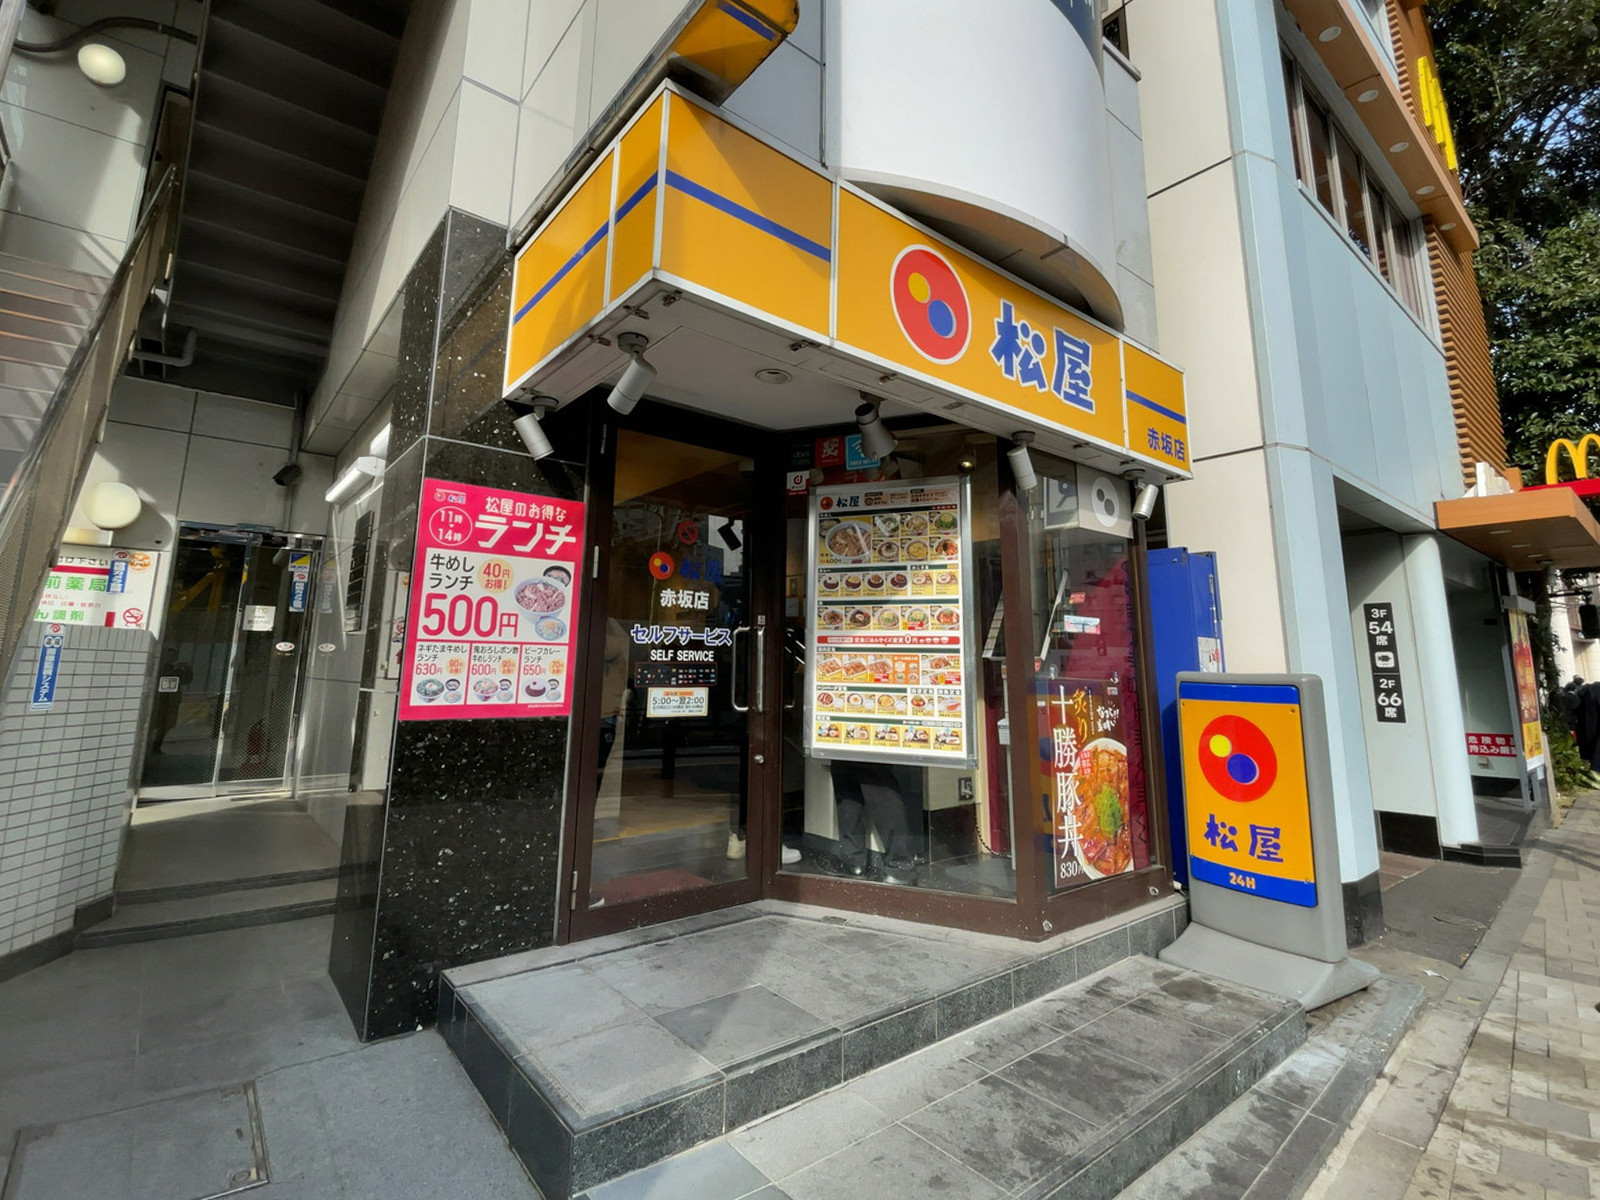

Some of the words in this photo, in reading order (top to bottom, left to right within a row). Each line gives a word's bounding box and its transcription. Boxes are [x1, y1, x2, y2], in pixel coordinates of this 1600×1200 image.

[989, 299, 1096, 414] 松屋
[1147, 427, 1185, 462] 赤坂店
[836, 495, 860, 508] 松屋
[485, 496, 567, 522] 松屋のお得な
[440, 509, 463, 524] 11時
[438, 528, 462, 542] 14時
[475, 514, 577, 556] ランチ
[430, 553, 475, 573] 牛めし
[483, 563, 510, 579] 40円
[46, 575, 107, 592] 前薬局
[429, 572, 474, 591] ランチ
[660, 588, 710, 610] 赤坂店
[421, 592, 519, 638] 500円
[1371, 608, 1387, 618] 3F
[1369, 621, 1393, 634] 54
[631, 624, 733, 646] セルフサービス
[1376, 635, 1388, 645] 席
[417, 644, 467, 654] ネギたま牛めし
[524, 646, 561, 656] ビーフカレー
[650, 649, 674, 661] SELF
[677, 650, 714, 662] SERVICE
[417, 653, 438, 662] ランチ
[472, 656, 502, 664] 牛めしランチ
[523, 656, 543, 664] ランチ
[415, 663, 443, 675] 630円
[471, 664, 497, 676] 600円
[523, 664, 546, 676] 650円
[1379, 679, 1396, 689] 2F
[1377, 692, 1402, 706] 66
[1073, 688, 1088, 744] 炙り
[1385, 707, 1397, 718] 席
[1051, 684, 1085, 860] 十勝豚丼
[1204, 813, 1283, 863] 松屋
[1228, 871, 1256, 890] 24H
